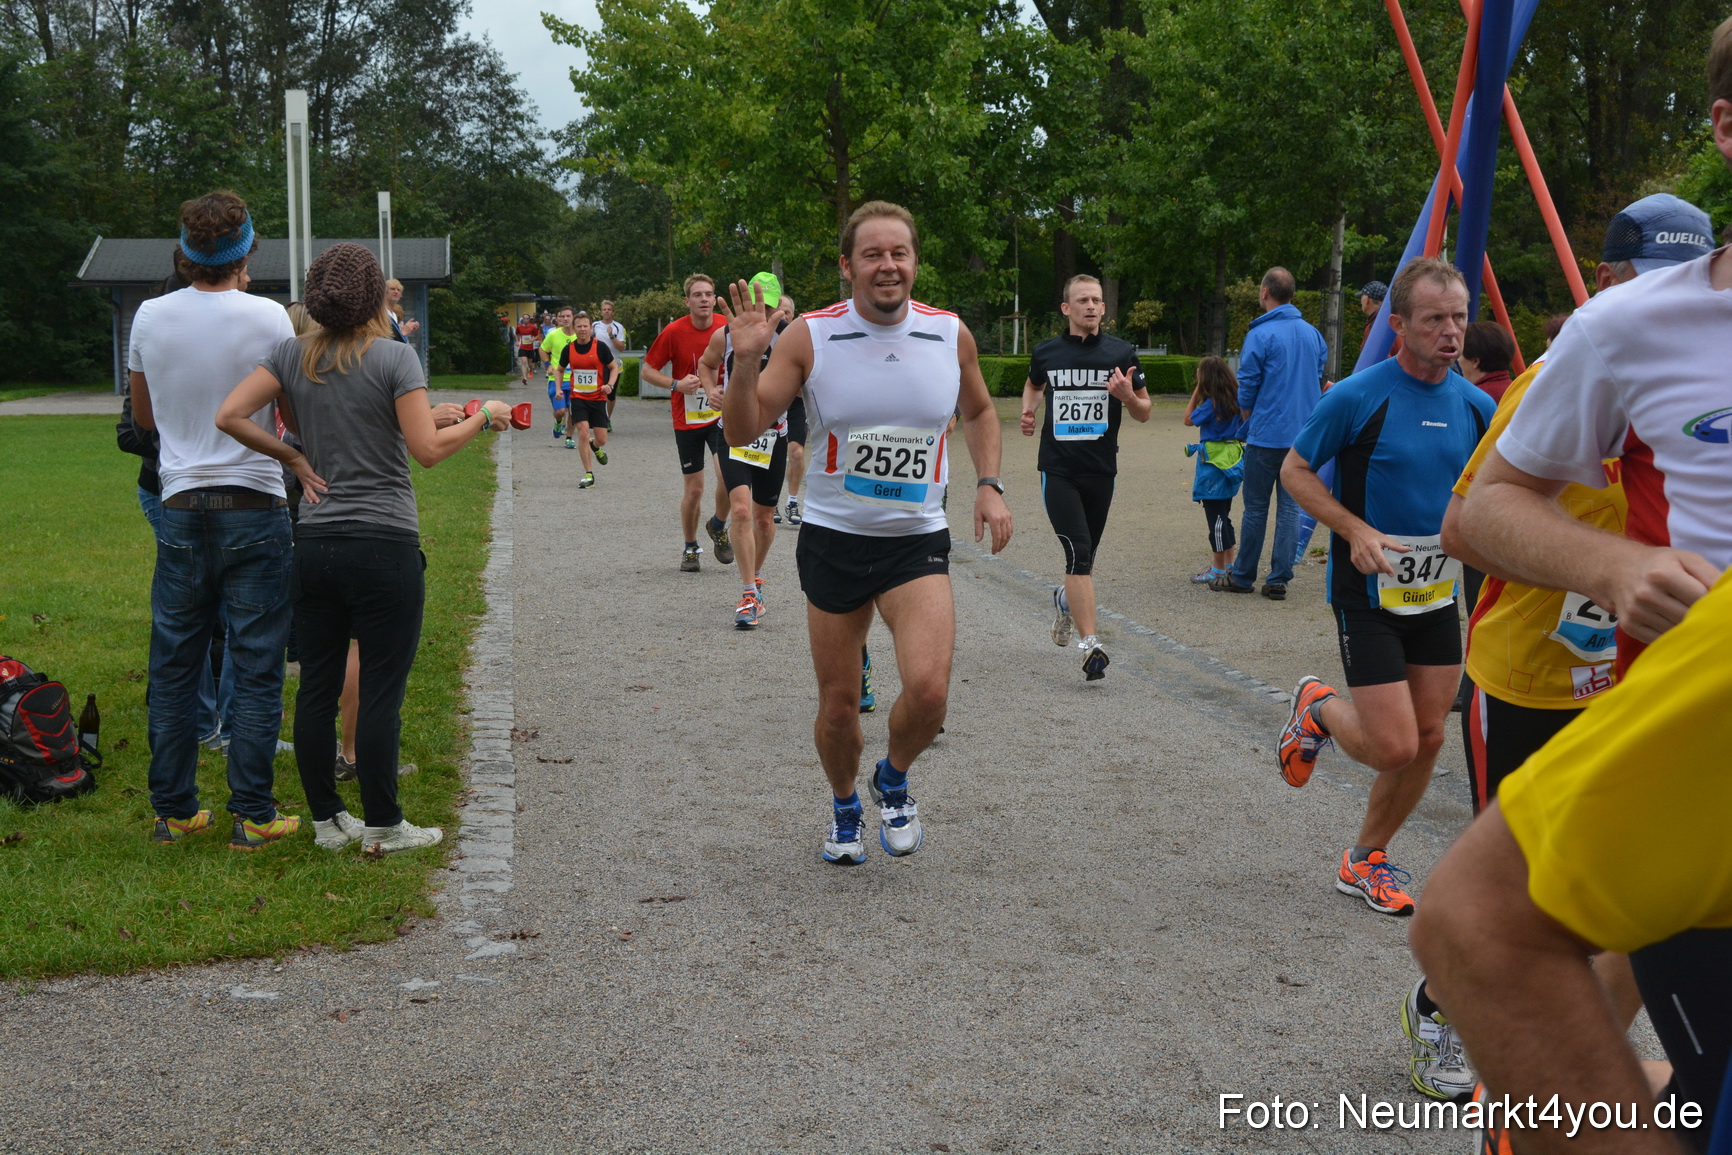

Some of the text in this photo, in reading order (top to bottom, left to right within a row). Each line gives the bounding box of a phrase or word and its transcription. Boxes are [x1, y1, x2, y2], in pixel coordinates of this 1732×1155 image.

[578, 375, 592, 384] 613
[1047, 369, 1109, 387] THULE
[1059, 402, 1103, 421] 2678
[1068, 425, 1094, 434] Markus
[747, 438, 768, 451] 94
[850, 432, 923, 445] PARTL Neumarkt
[744, 451, 760, 461] Bernd
[854, 445, 927, 479] 2525
[874, 484, 903, 498] Gerd
[190, 495, 233, 508] PMA
[1397, 554, 1448, 585] 347
[1403, 590, 1435, 603] Günter
[1566, 612, 1572, 620] B
